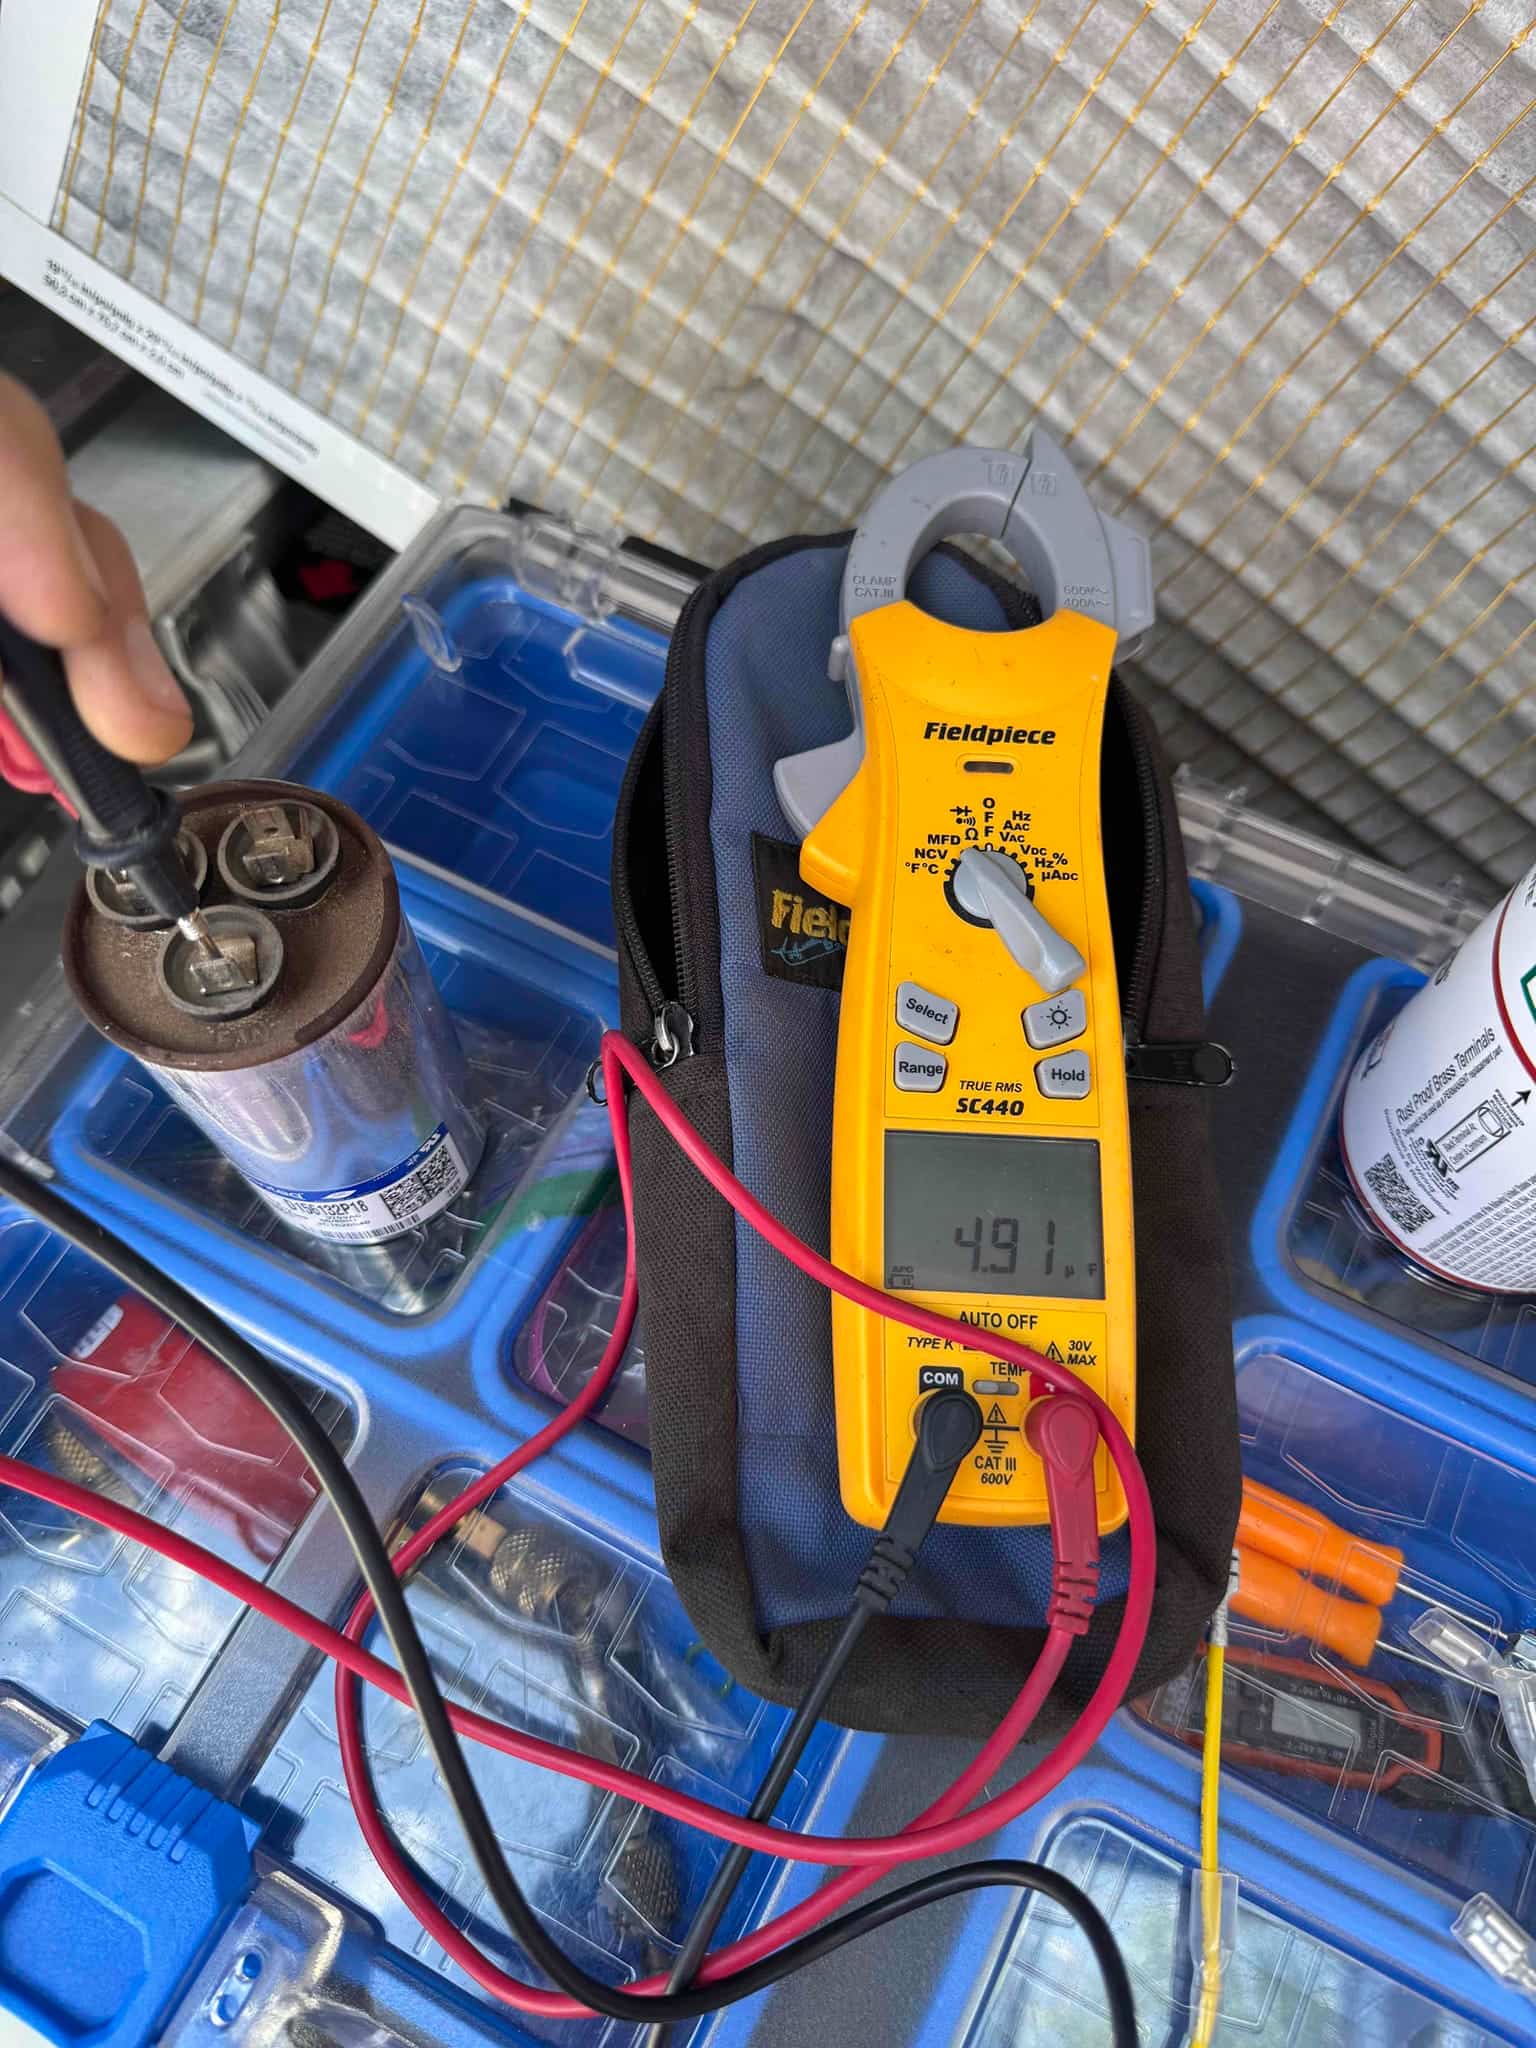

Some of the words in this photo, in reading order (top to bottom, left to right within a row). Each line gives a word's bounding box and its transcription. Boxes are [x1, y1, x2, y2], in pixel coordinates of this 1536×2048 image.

[853, 575, 896, 586] CLAMP
[924, 722, 1056, 745] Fieldpiece
[1012, 811, 1031, 821] Hz
[927, 834, 961, 845] MFD
[914, 849, 947, 859] NCV
[906, 998, 949, 1025] Select
[899, 1061, 943, 1077] Range
[1051, 1068, 1085, 1081] Hold
[1395, 1099, 1416, 1125] Rust
[1412, 1080, 1435, 1110] Proof
[1432, 1064, 1456, 1093] Brass
[1454, 1026, 1495, 1070] Terminals
[959, 1080, 991, 1091] TRUE
[995, 1081, 1023, 1092] RMS
[956, 1098, 1024, 1116] SC440
[954, 1216, 1056, 1275] 4.91
[959, 1311, 1003, 1328] AUTO
[1007, 1313, 1038, 1330] OFF
[907, 1336, 943, 1349] TYPE
[944, 1338, 954, 1350] K
[1068, 1340, 1092, 1351] 30V
[1067, 1354, 1097, 1366] MAX
[923, 1371, 959, 1385] COM
[974, 1456, 1001, 1470] CAT
[981, 1472, 1013, 1485] 600V
